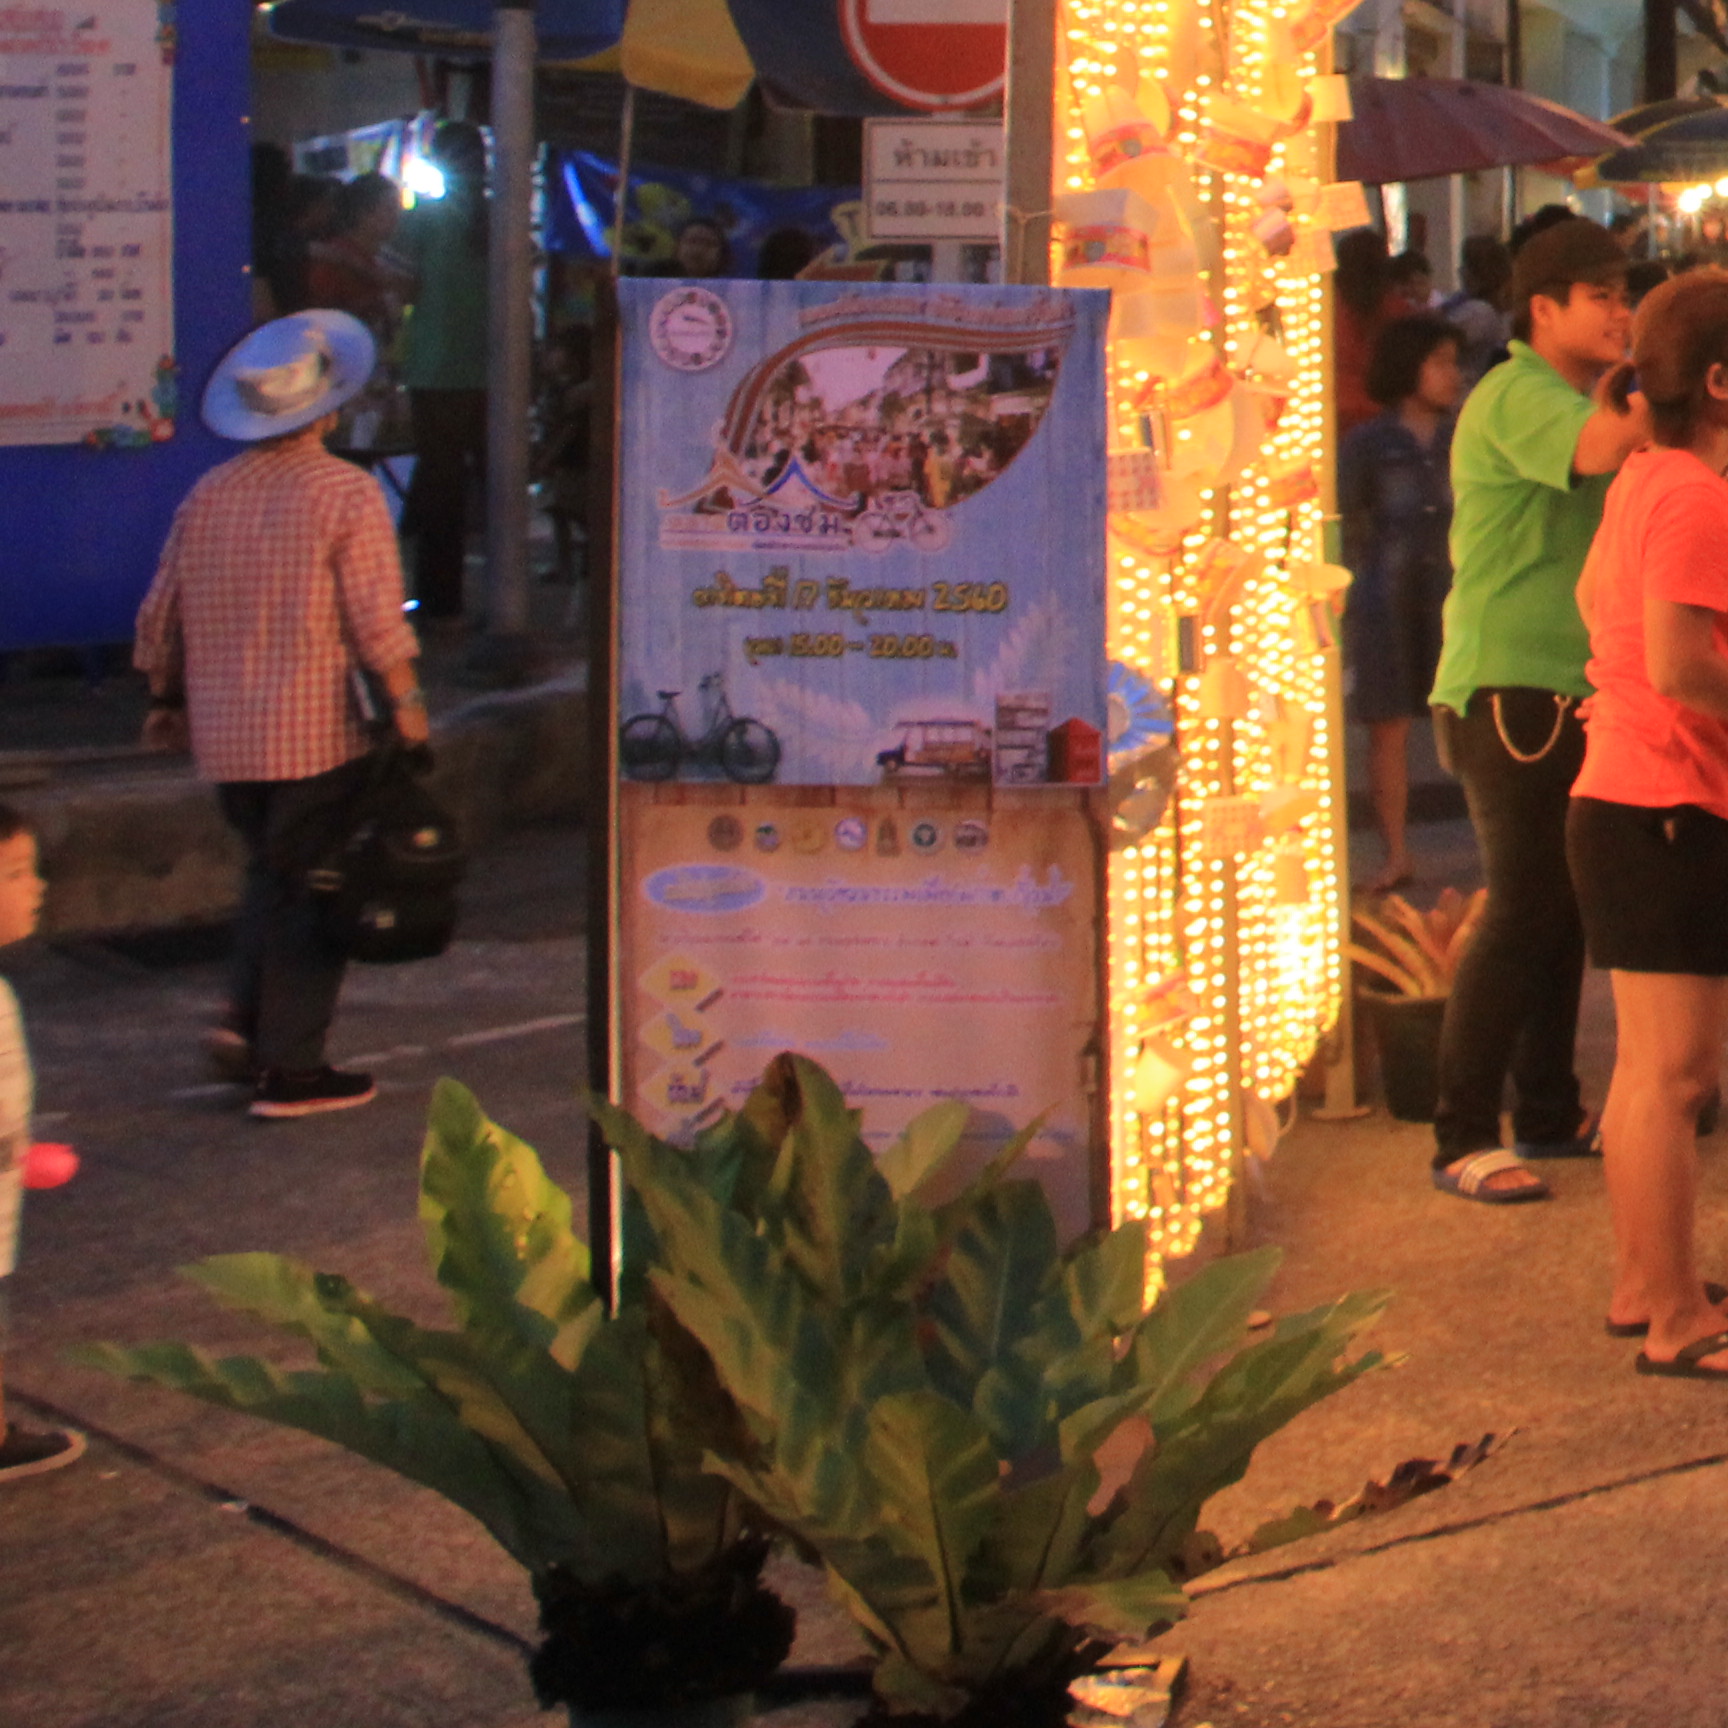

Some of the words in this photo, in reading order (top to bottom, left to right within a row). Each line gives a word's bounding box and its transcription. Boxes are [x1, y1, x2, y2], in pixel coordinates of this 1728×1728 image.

[893, 137, 998, 168] ห้ามเข้า
[930, 580, 1009, 613] 2560
